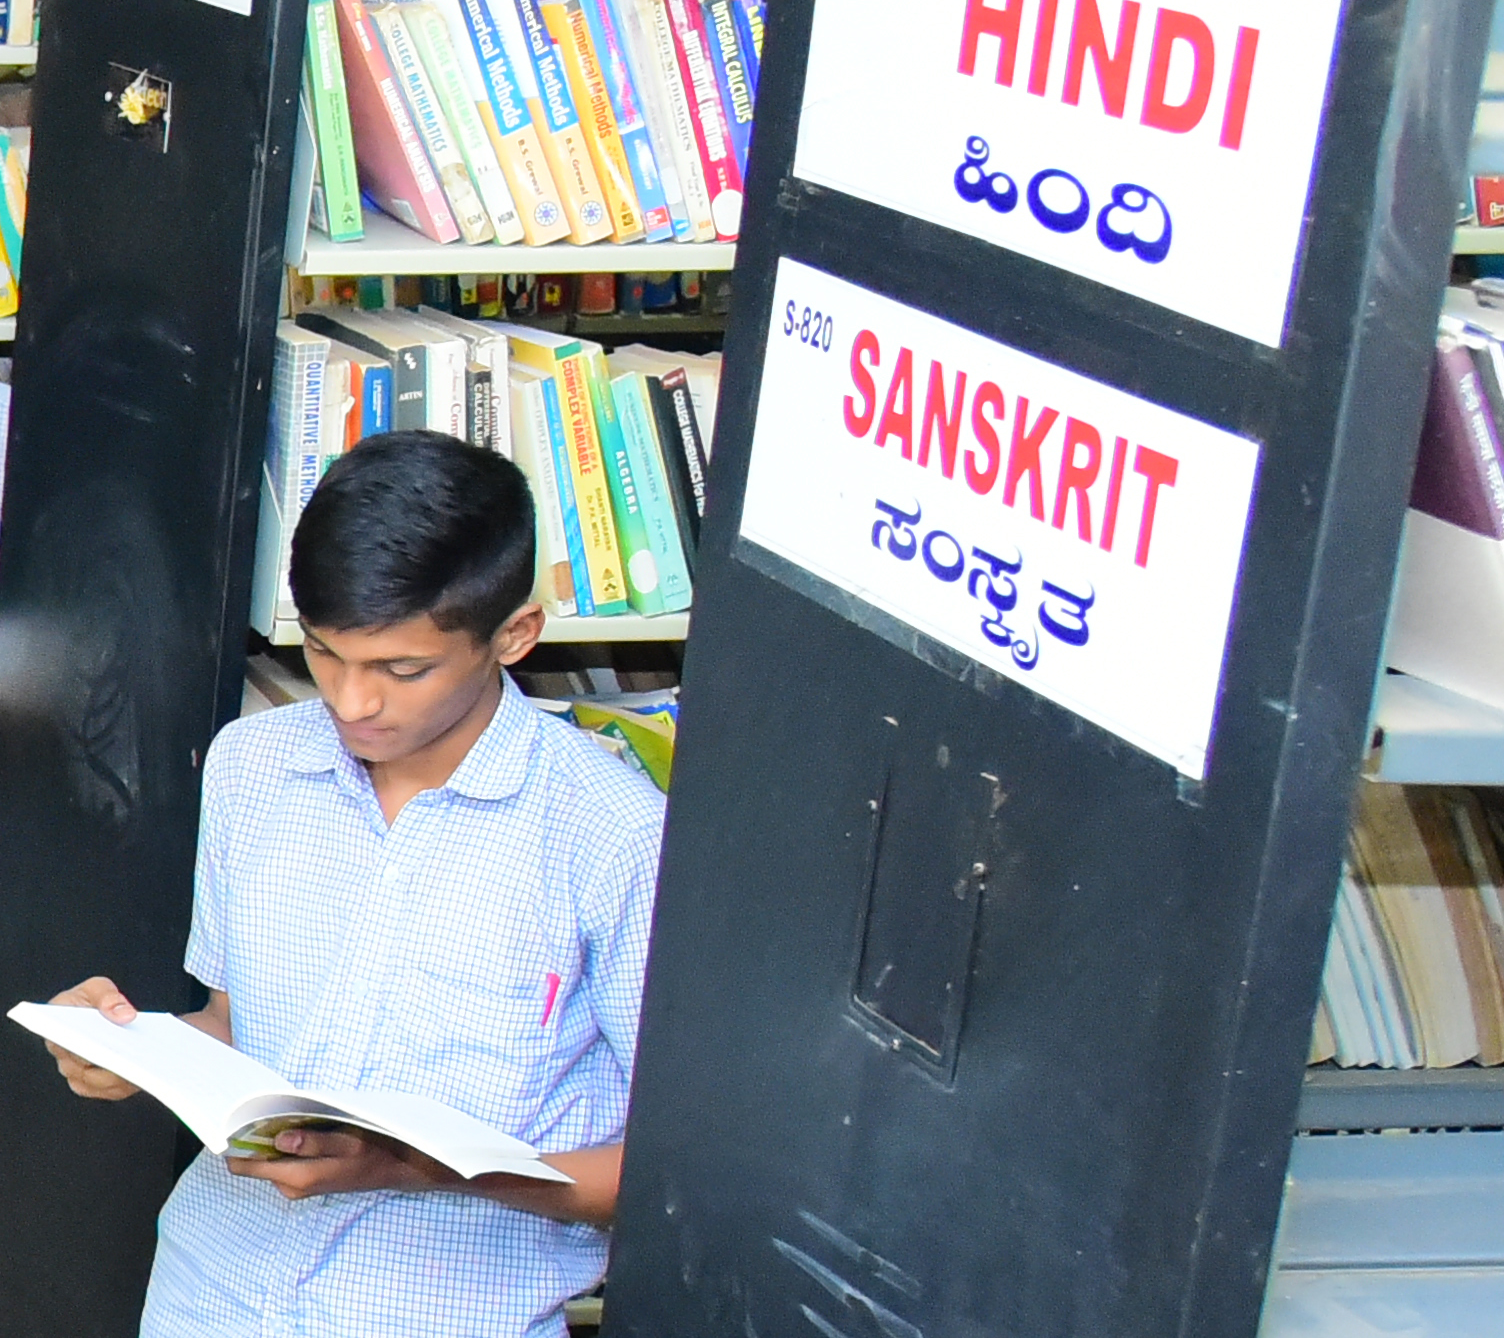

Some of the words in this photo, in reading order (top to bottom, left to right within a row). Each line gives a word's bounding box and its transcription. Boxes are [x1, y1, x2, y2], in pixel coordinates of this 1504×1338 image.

[709, 2, 739, 69] INTEGRAL
[487, 57, 521, 129] Methods
[536, 48, 568, 126] Methods
[569, 9, 600, 82] Numerical
[587, 78, 612, 139] Methods
[723, 65, 753, 125] CALCULUS
[953, 134, 1173, 264] ಹಿಂದಿ
[783, 298, 833, 353] S-820
[560, 359, 581, 417] COMPLEX
[570, 418, 589, 476] VARIABLE
[842, 328, 1179, 568] SANSKRIT
[616, 450, 637, 515] ALGEBRA
[870, 497, 1097, 671] ಸಂಸ್ಕೃತ
